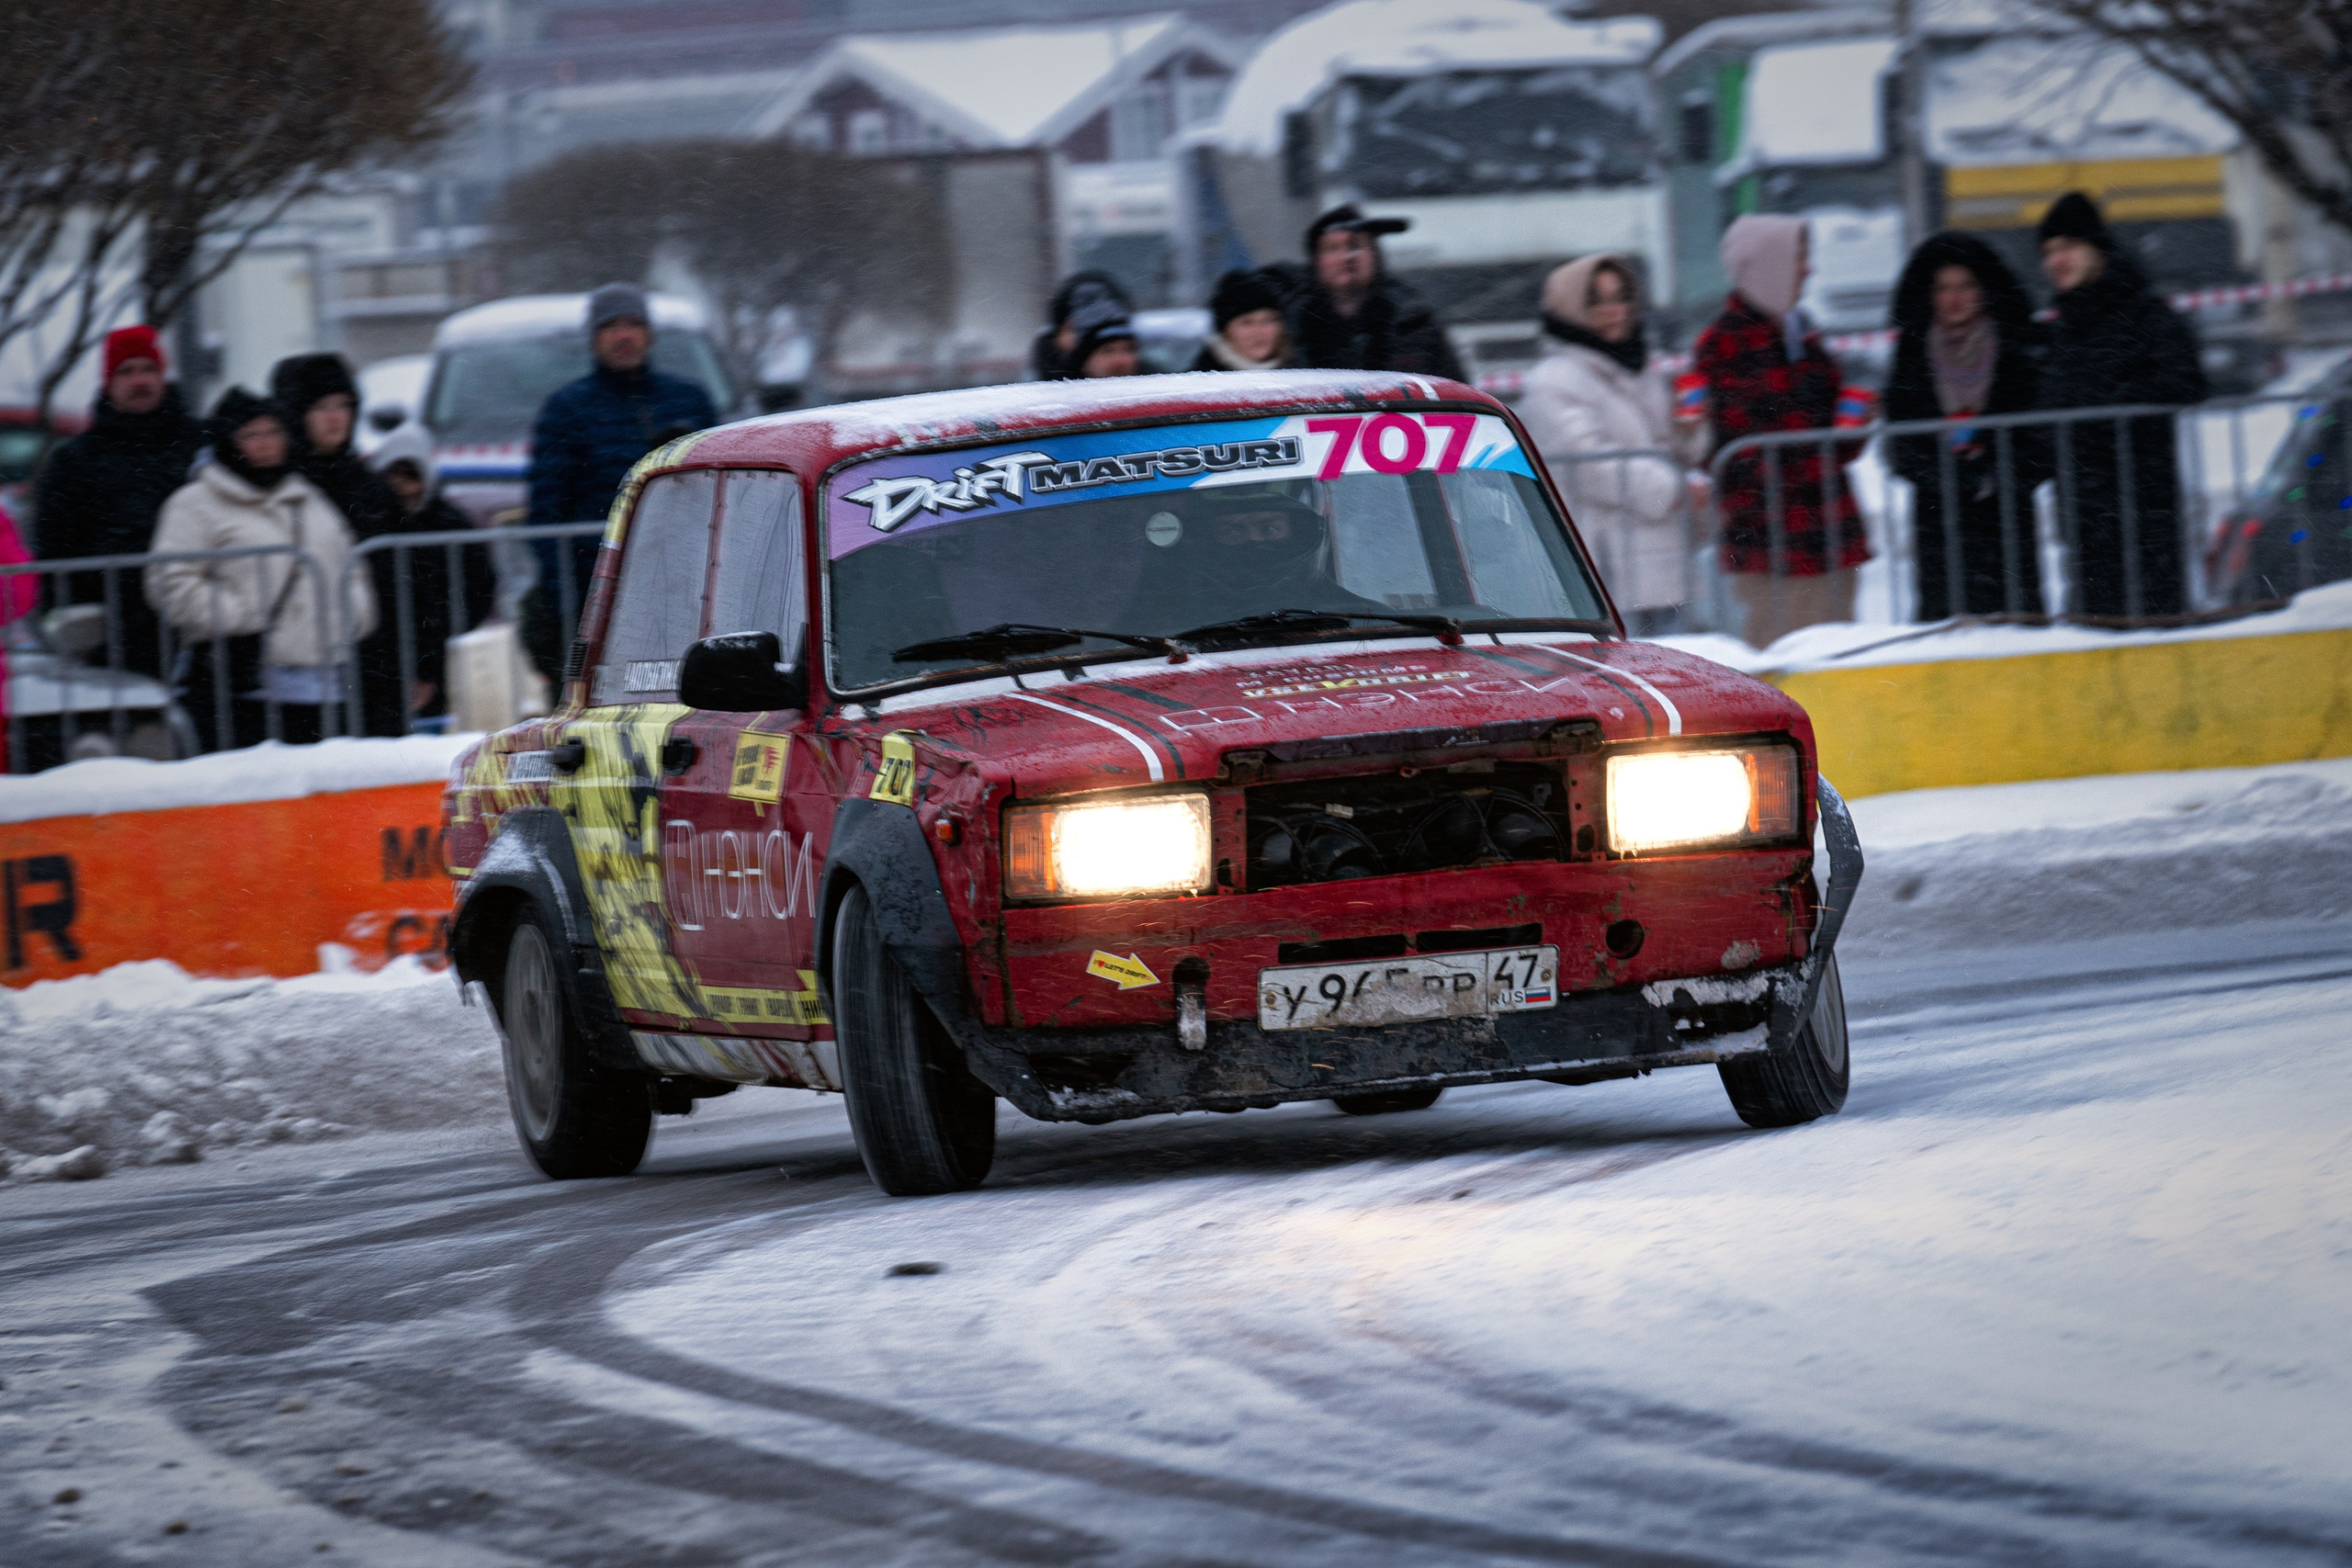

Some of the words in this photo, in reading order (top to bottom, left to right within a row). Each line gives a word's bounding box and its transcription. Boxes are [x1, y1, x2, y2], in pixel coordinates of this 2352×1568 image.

[1028, 437, 1300, 493] MATSURI
[1303, 412, 1478, 481] 707
[1494, 953, 1538, 988] 47
